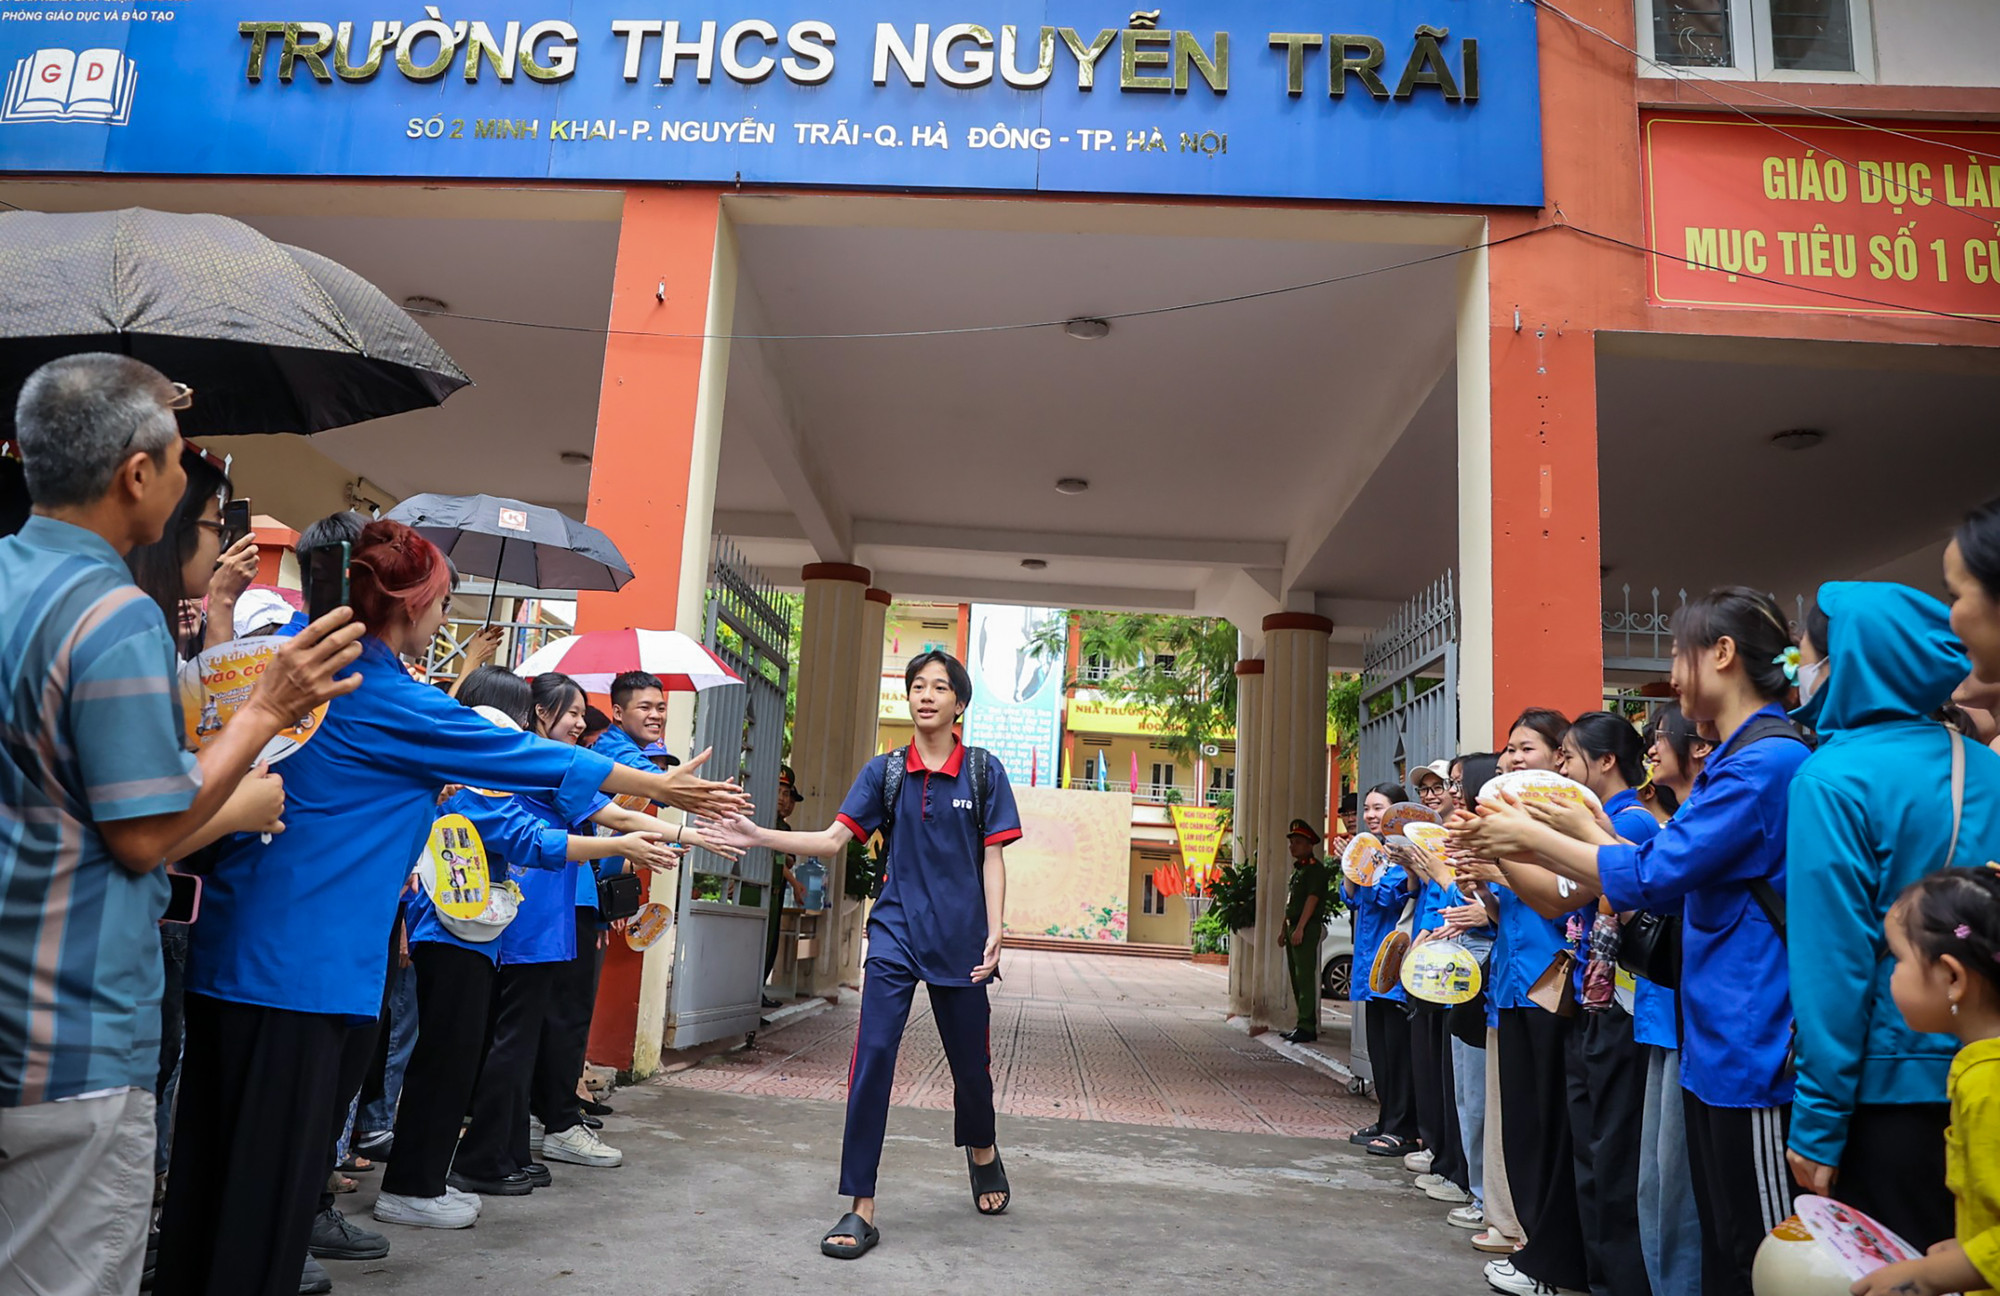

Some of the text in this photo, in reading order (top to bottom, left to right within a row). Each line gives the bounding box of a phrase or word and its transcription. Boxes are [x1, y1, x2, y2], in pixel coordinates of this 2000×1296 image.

[2, 9, 174, 23] PHÒNG GIÁO DỤC VÀ ĐÀO TẠO
[239, 5, 1479, 102] TRƯỜNG THCS NGUYỄN TRÃI
[41, 62, 104, 83] G D
[405, 113, 444, 139] SỐ
[448, 119, 464, 139] 2
[473, 118, 538, 140] MINH
[660, 117, 775, 144] NGUYỄN
[910, 118, 949, 149] HÀ
[967, 123, 1051, 150] ĐÔNG
[1076, 130, 1117, 152] TP.
[1126, 127, 1168, 153] HÀ
[1179, 130, 1228, 159] NỘI
[1762, 149, 1848, 203] GIÁO
[1858, 161, 1932, 214] DỤC
[1685, 227, 1768, 282] MỤC
[1777, 223, 1857, 278] TIÊU
[1869, 221, 1918, 281] SỐ
[1930, 239, 1948, 282] 1
[244, 657, 268, 677] cấ
[1075, 703, 1100, 714] NHÀ
